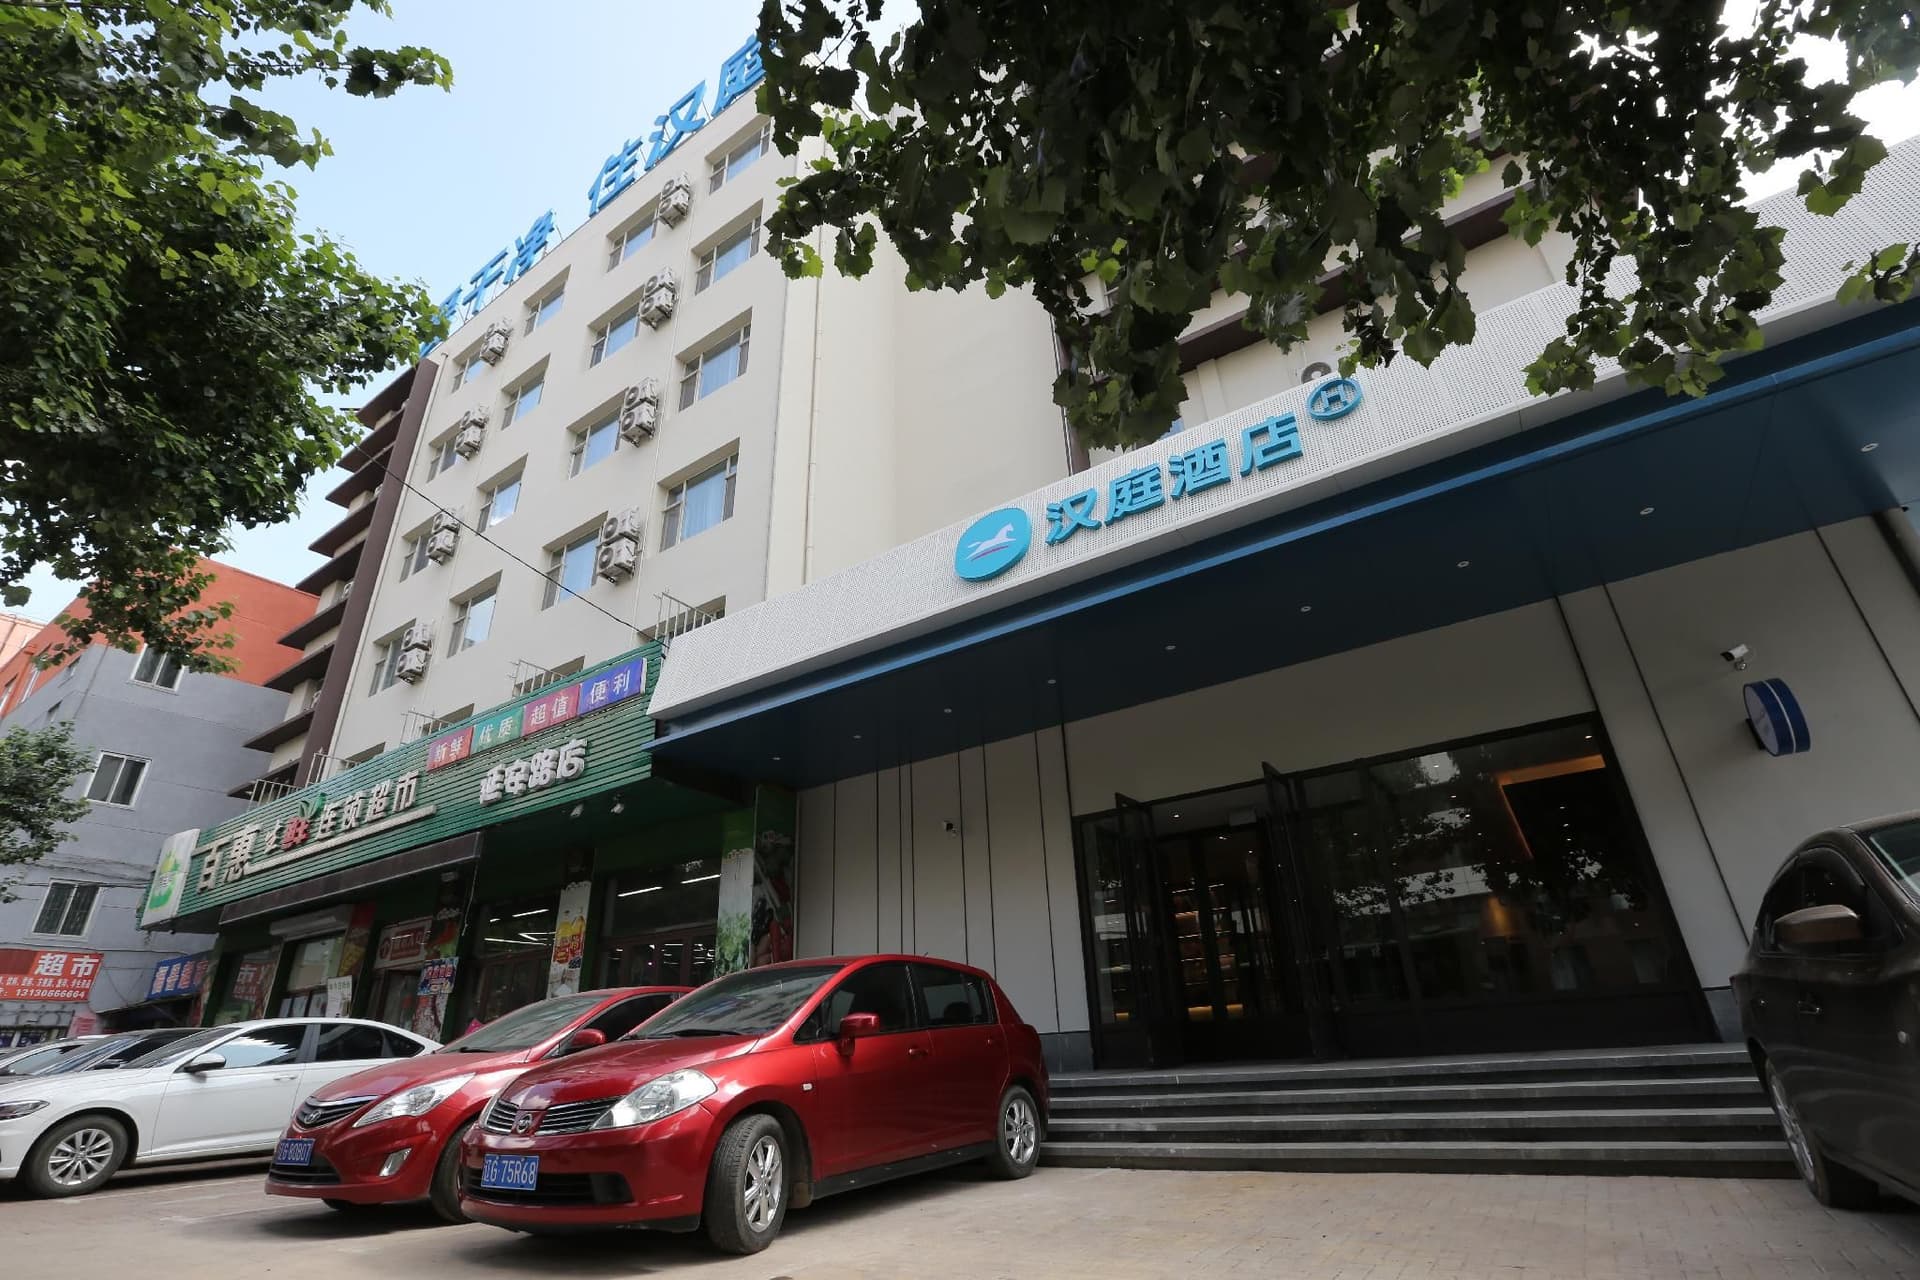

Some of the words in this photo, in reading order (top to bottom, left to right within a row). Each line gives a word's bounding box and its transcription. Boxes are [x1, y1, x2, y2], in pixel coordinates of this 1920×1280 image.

[421, 207, 556, 350] 干净
[588, 34, 766, 218] 住汉庭
[1046, 411, 1304, 546] 汉庭酒店
[436, 736, 465, 763] 新鲜
[479, 716, 514, 744] 优质
[530, 696, 569, 726] 超值
[590, 670, 631, 703] 便利
[480, 738, 588, 806] 延安路店
[34, 952, 99, 977] 超市
